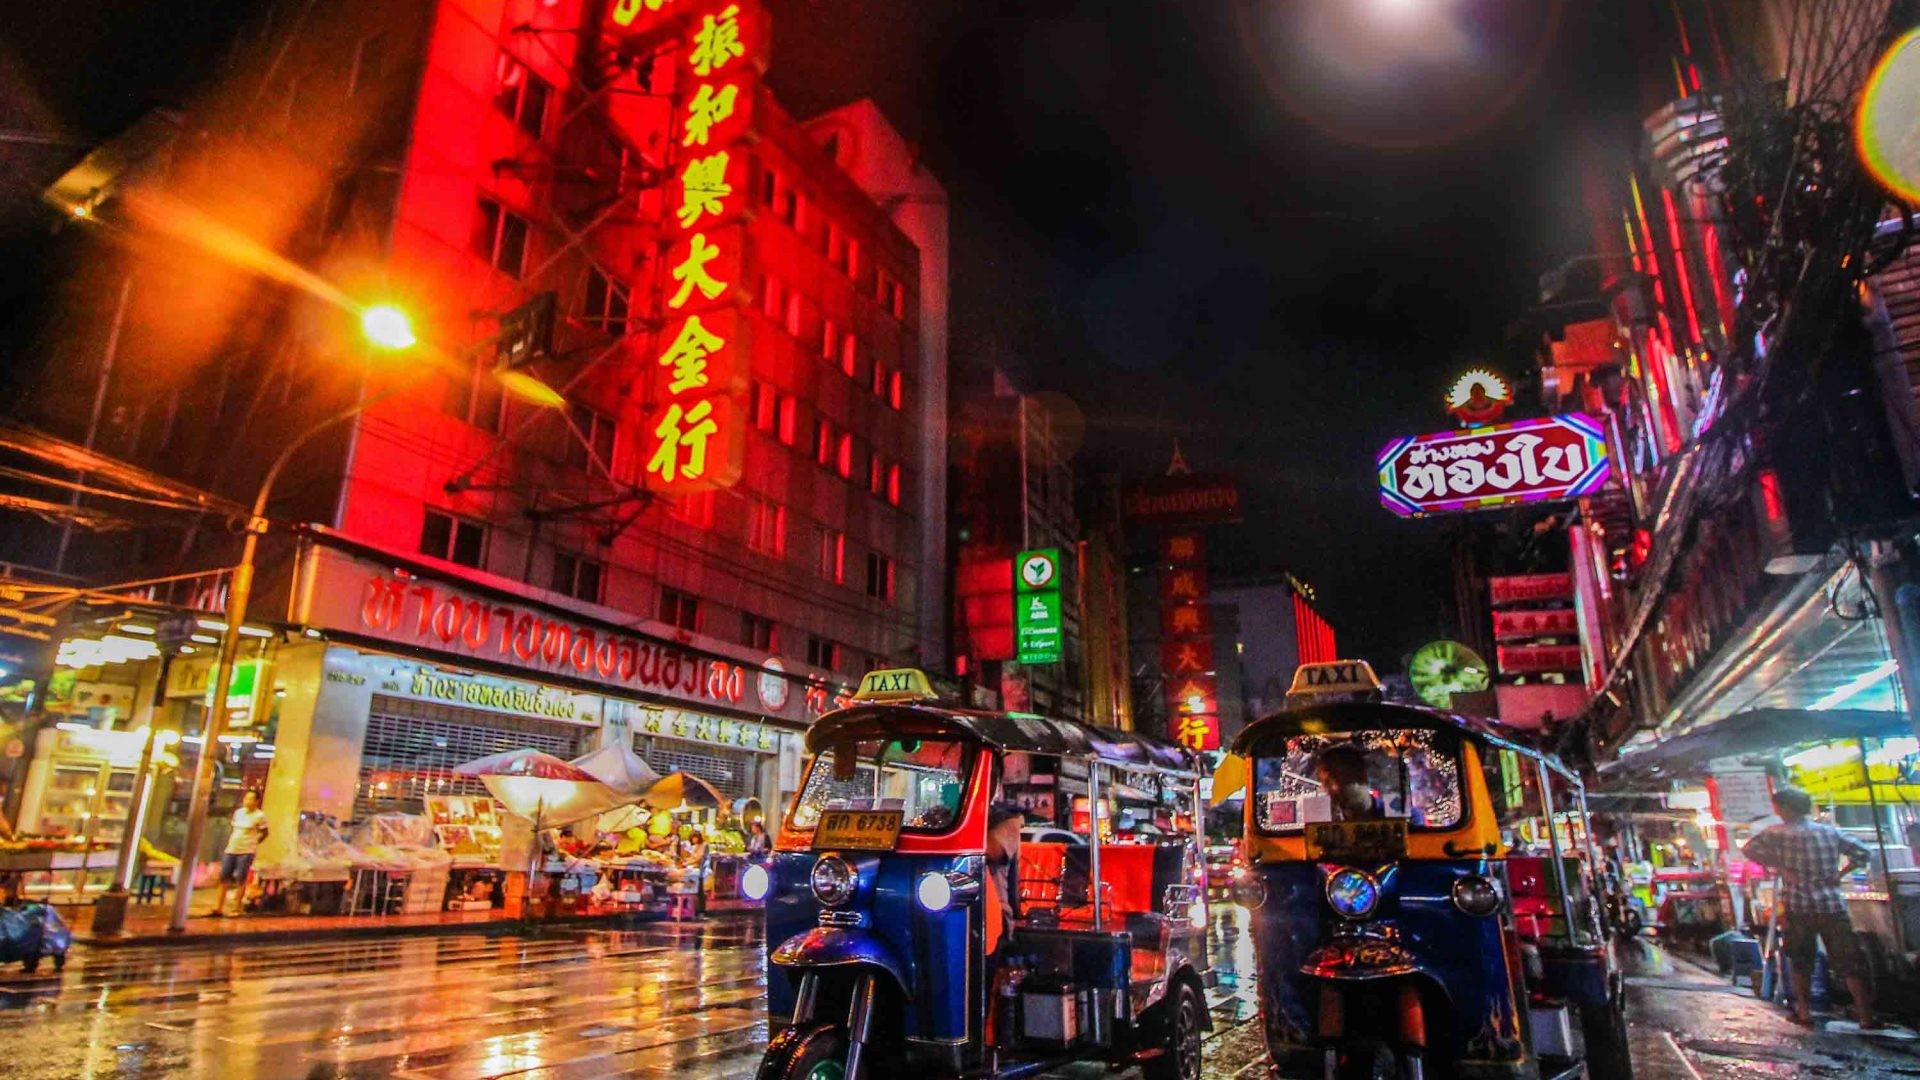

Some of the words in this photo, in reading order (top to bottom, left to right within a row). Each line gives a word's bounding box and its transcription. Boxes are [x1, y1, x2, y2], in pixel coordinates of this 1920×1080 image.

[869, 673, 911, 692] TAXI
[1304, 666, 1359, 685] TAXI
[857, 814, 897, 831] 6738
